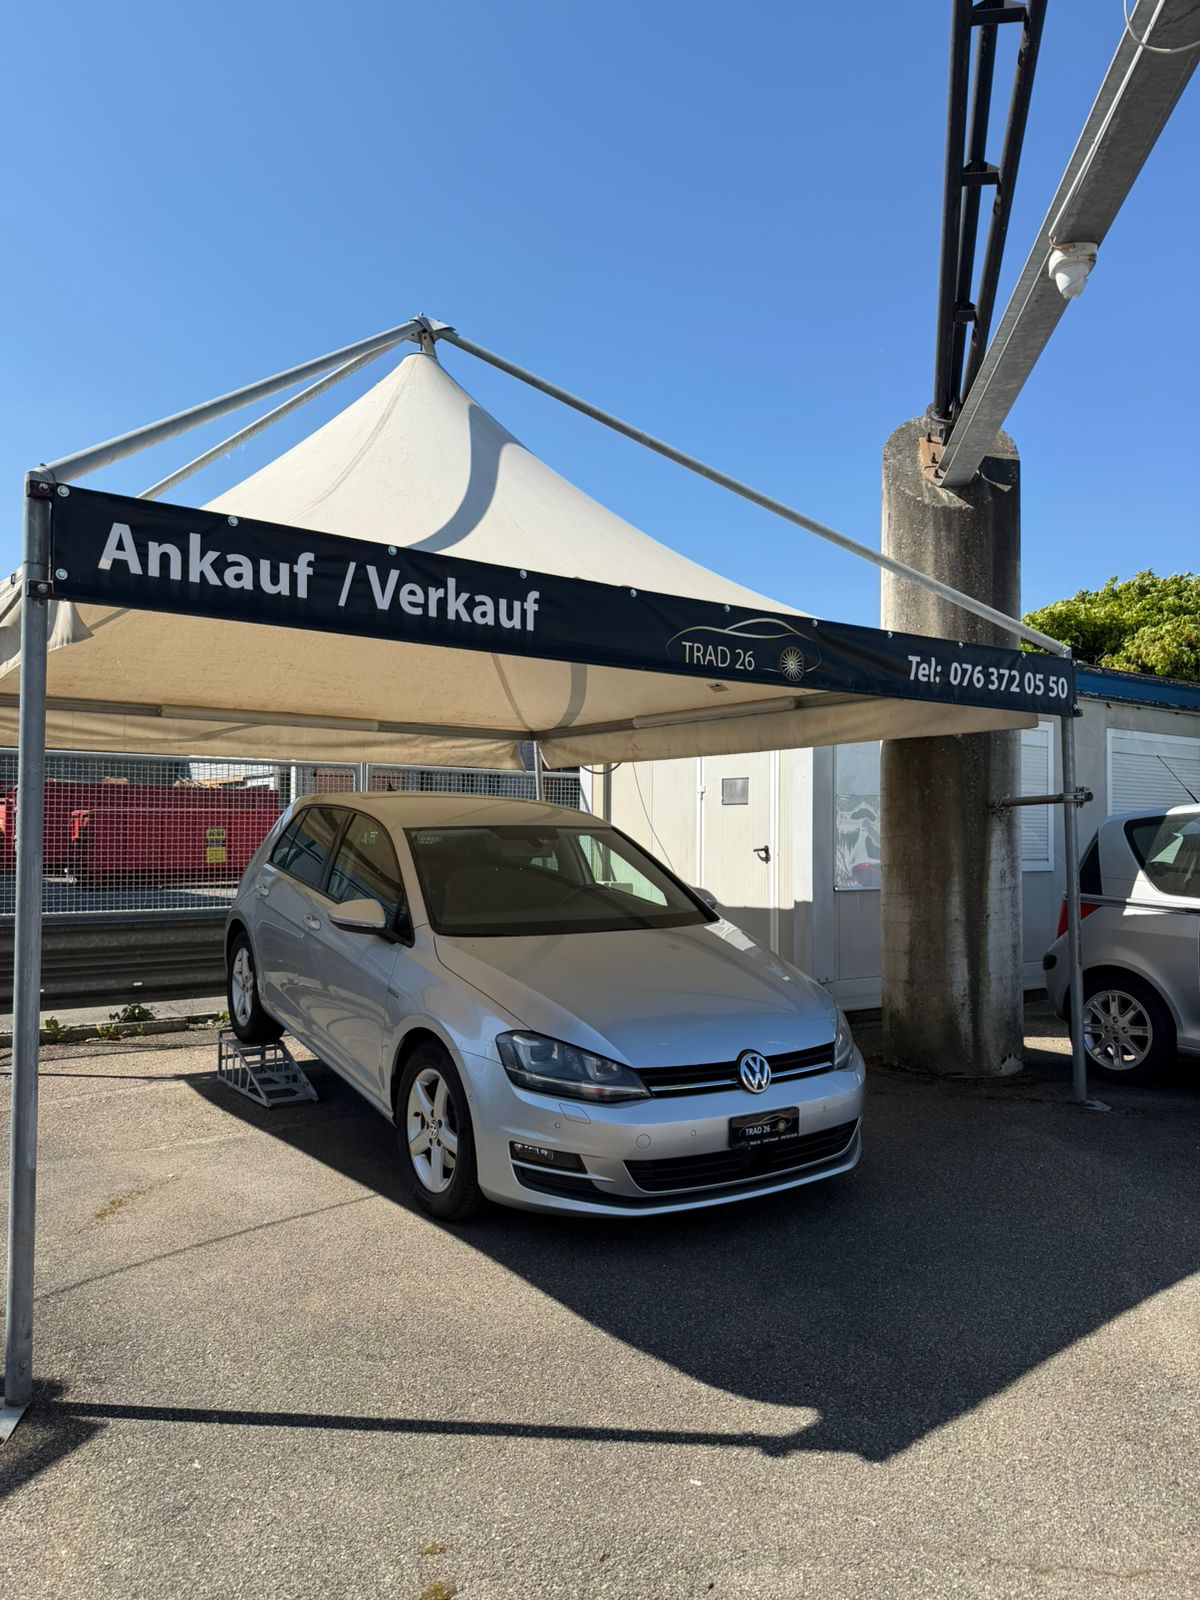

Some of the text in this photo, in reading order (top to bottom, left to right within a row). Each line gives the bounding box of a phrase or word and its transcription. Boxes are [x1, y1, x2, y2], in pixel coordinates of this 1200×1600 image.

[98, 522, 315, 599] Ankauf
[682, 641, 755, 671] TRAD 26
[908, 655, 1068, 699] Tel: 076 372 05 50
[745, 1125, 770, 1136] TRAD 26
